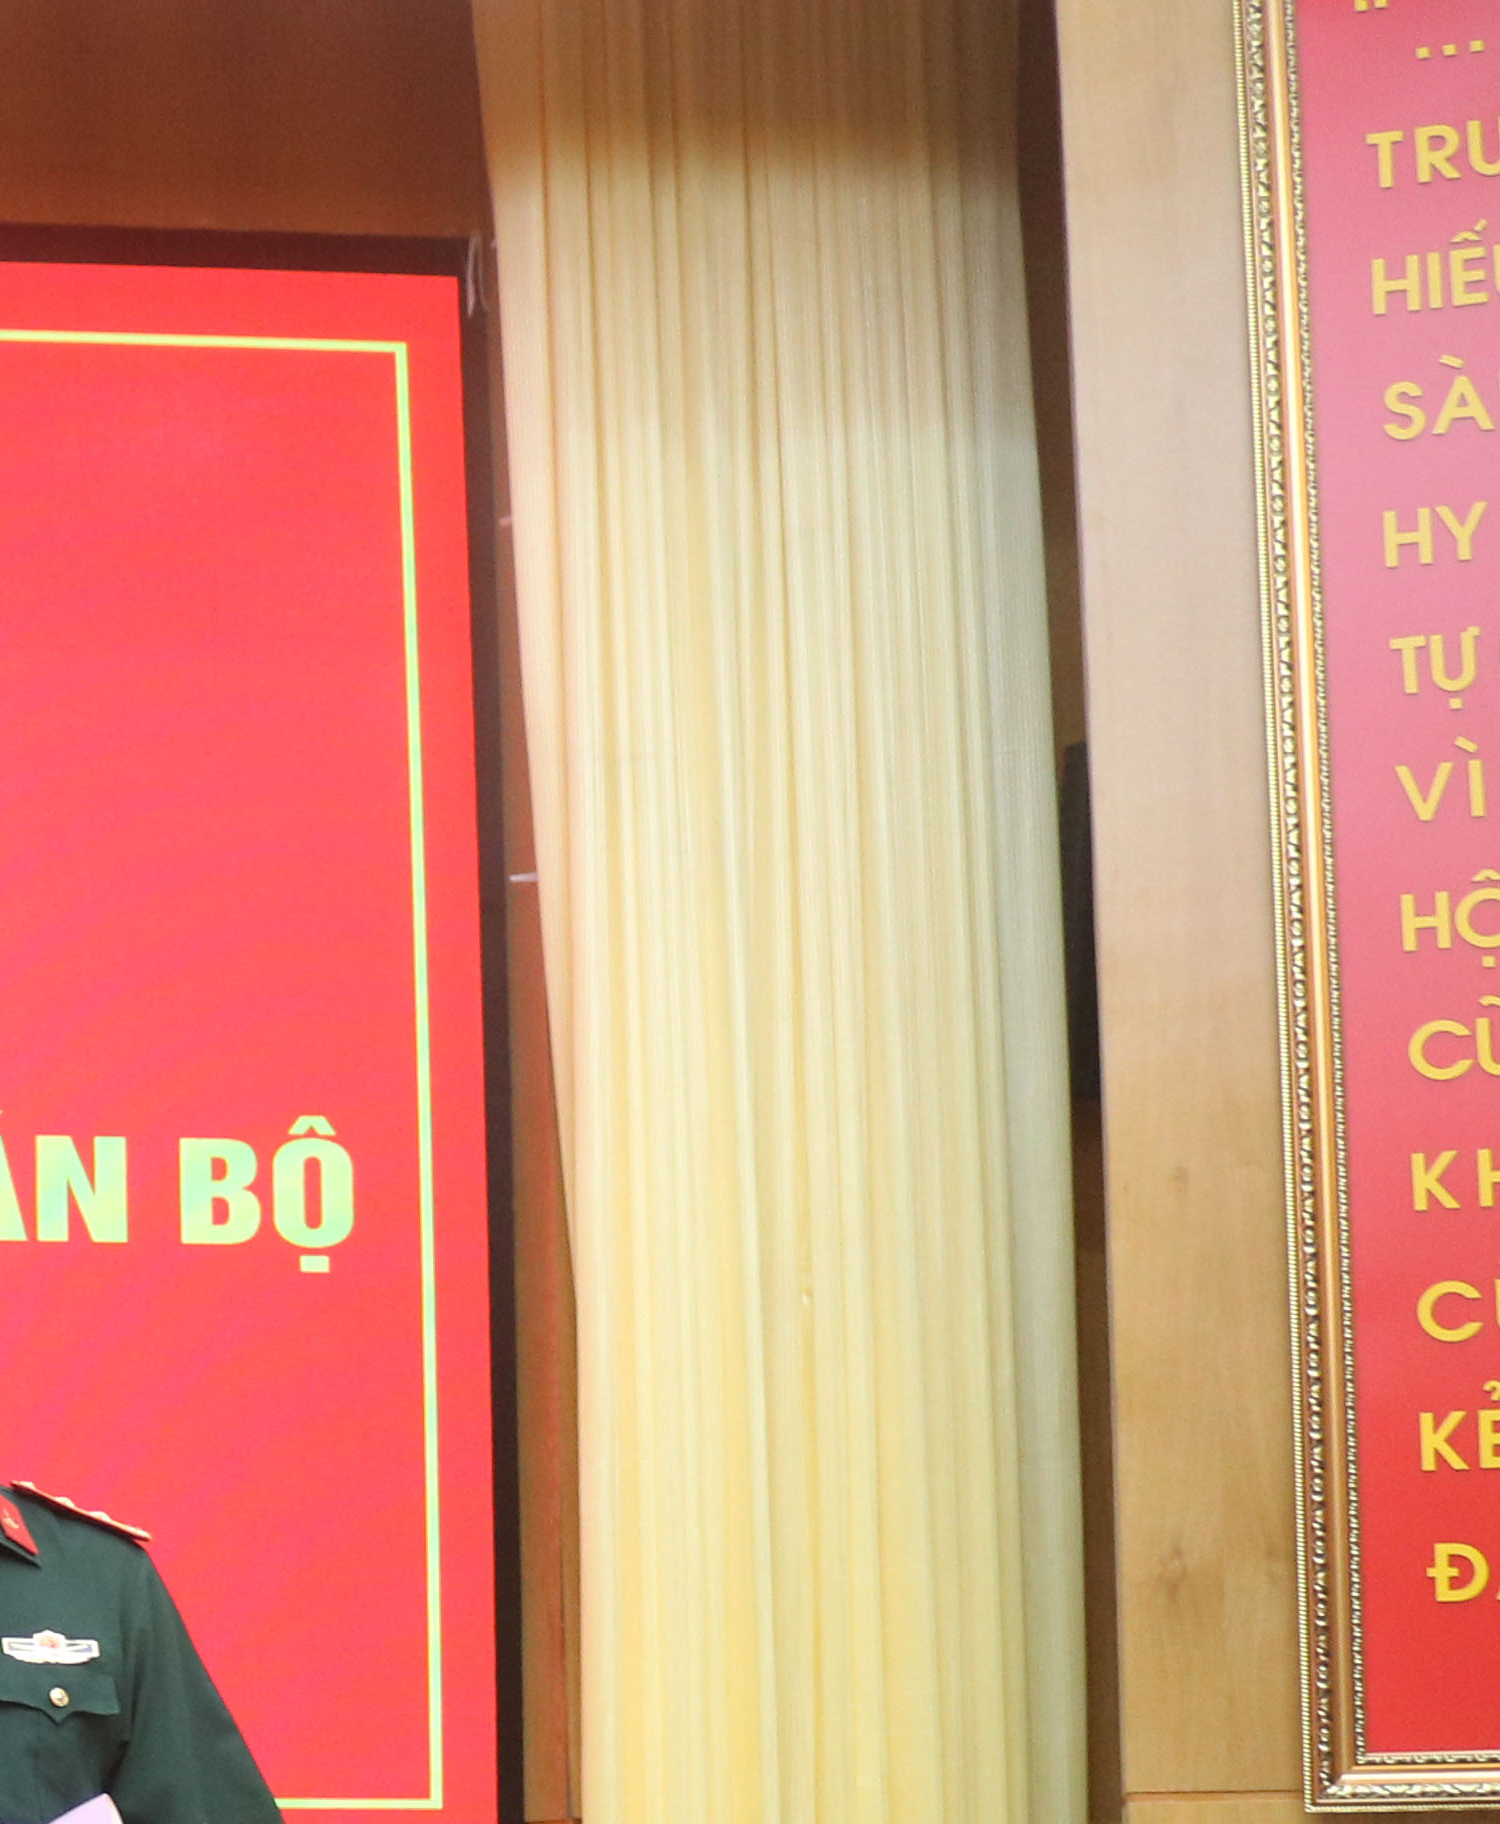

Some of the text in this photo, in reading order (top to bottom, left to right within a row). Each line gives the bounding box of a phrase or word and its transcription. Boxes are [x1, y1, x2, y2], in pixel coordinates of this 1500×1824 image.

[1370, 218, 1500, 316] HIẾ
[1382, 353, 1500, 441] SÀ
[1382, 500, 1490, 569] HY
[1388, 625, 1483, 711] TỰ
[1394, 735, 1489, 822] VÌ
[179, 1115, 356, 1273] BỘ
[1416, 1278, 1500, 1343] C
[1426, 1542, 1500, 1604] Đ
